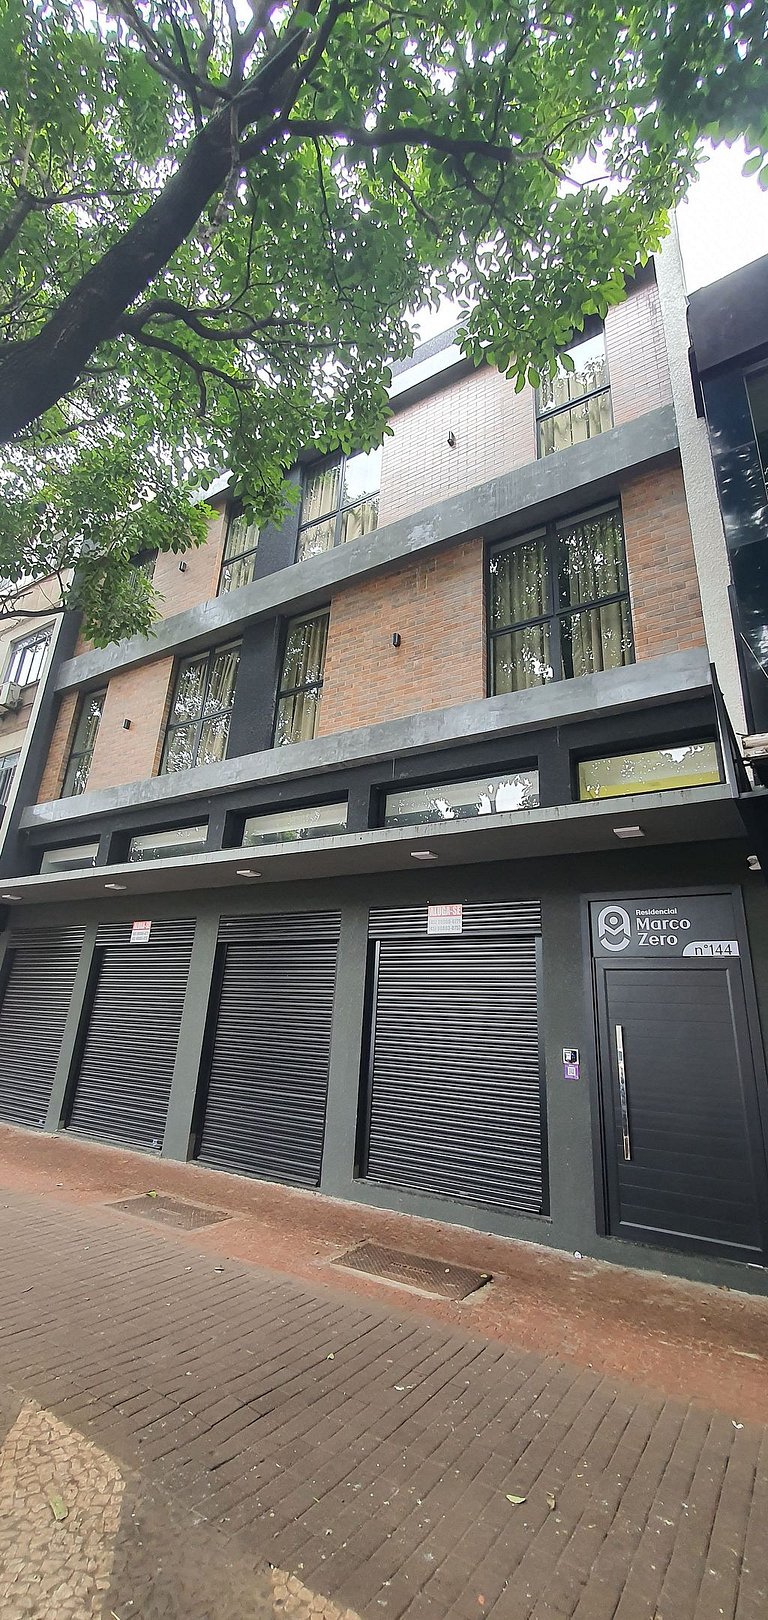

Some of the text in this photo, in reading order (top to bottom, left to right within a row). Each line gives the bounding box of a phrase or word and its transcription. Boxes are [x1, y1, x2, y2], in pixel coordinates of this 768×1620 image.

[635, 907, 678, 916] Residencial
[636, 917, 691, 931] Marco
[638, 932, 678, 946] Zero
[694, 943, 733, 956] n°144
